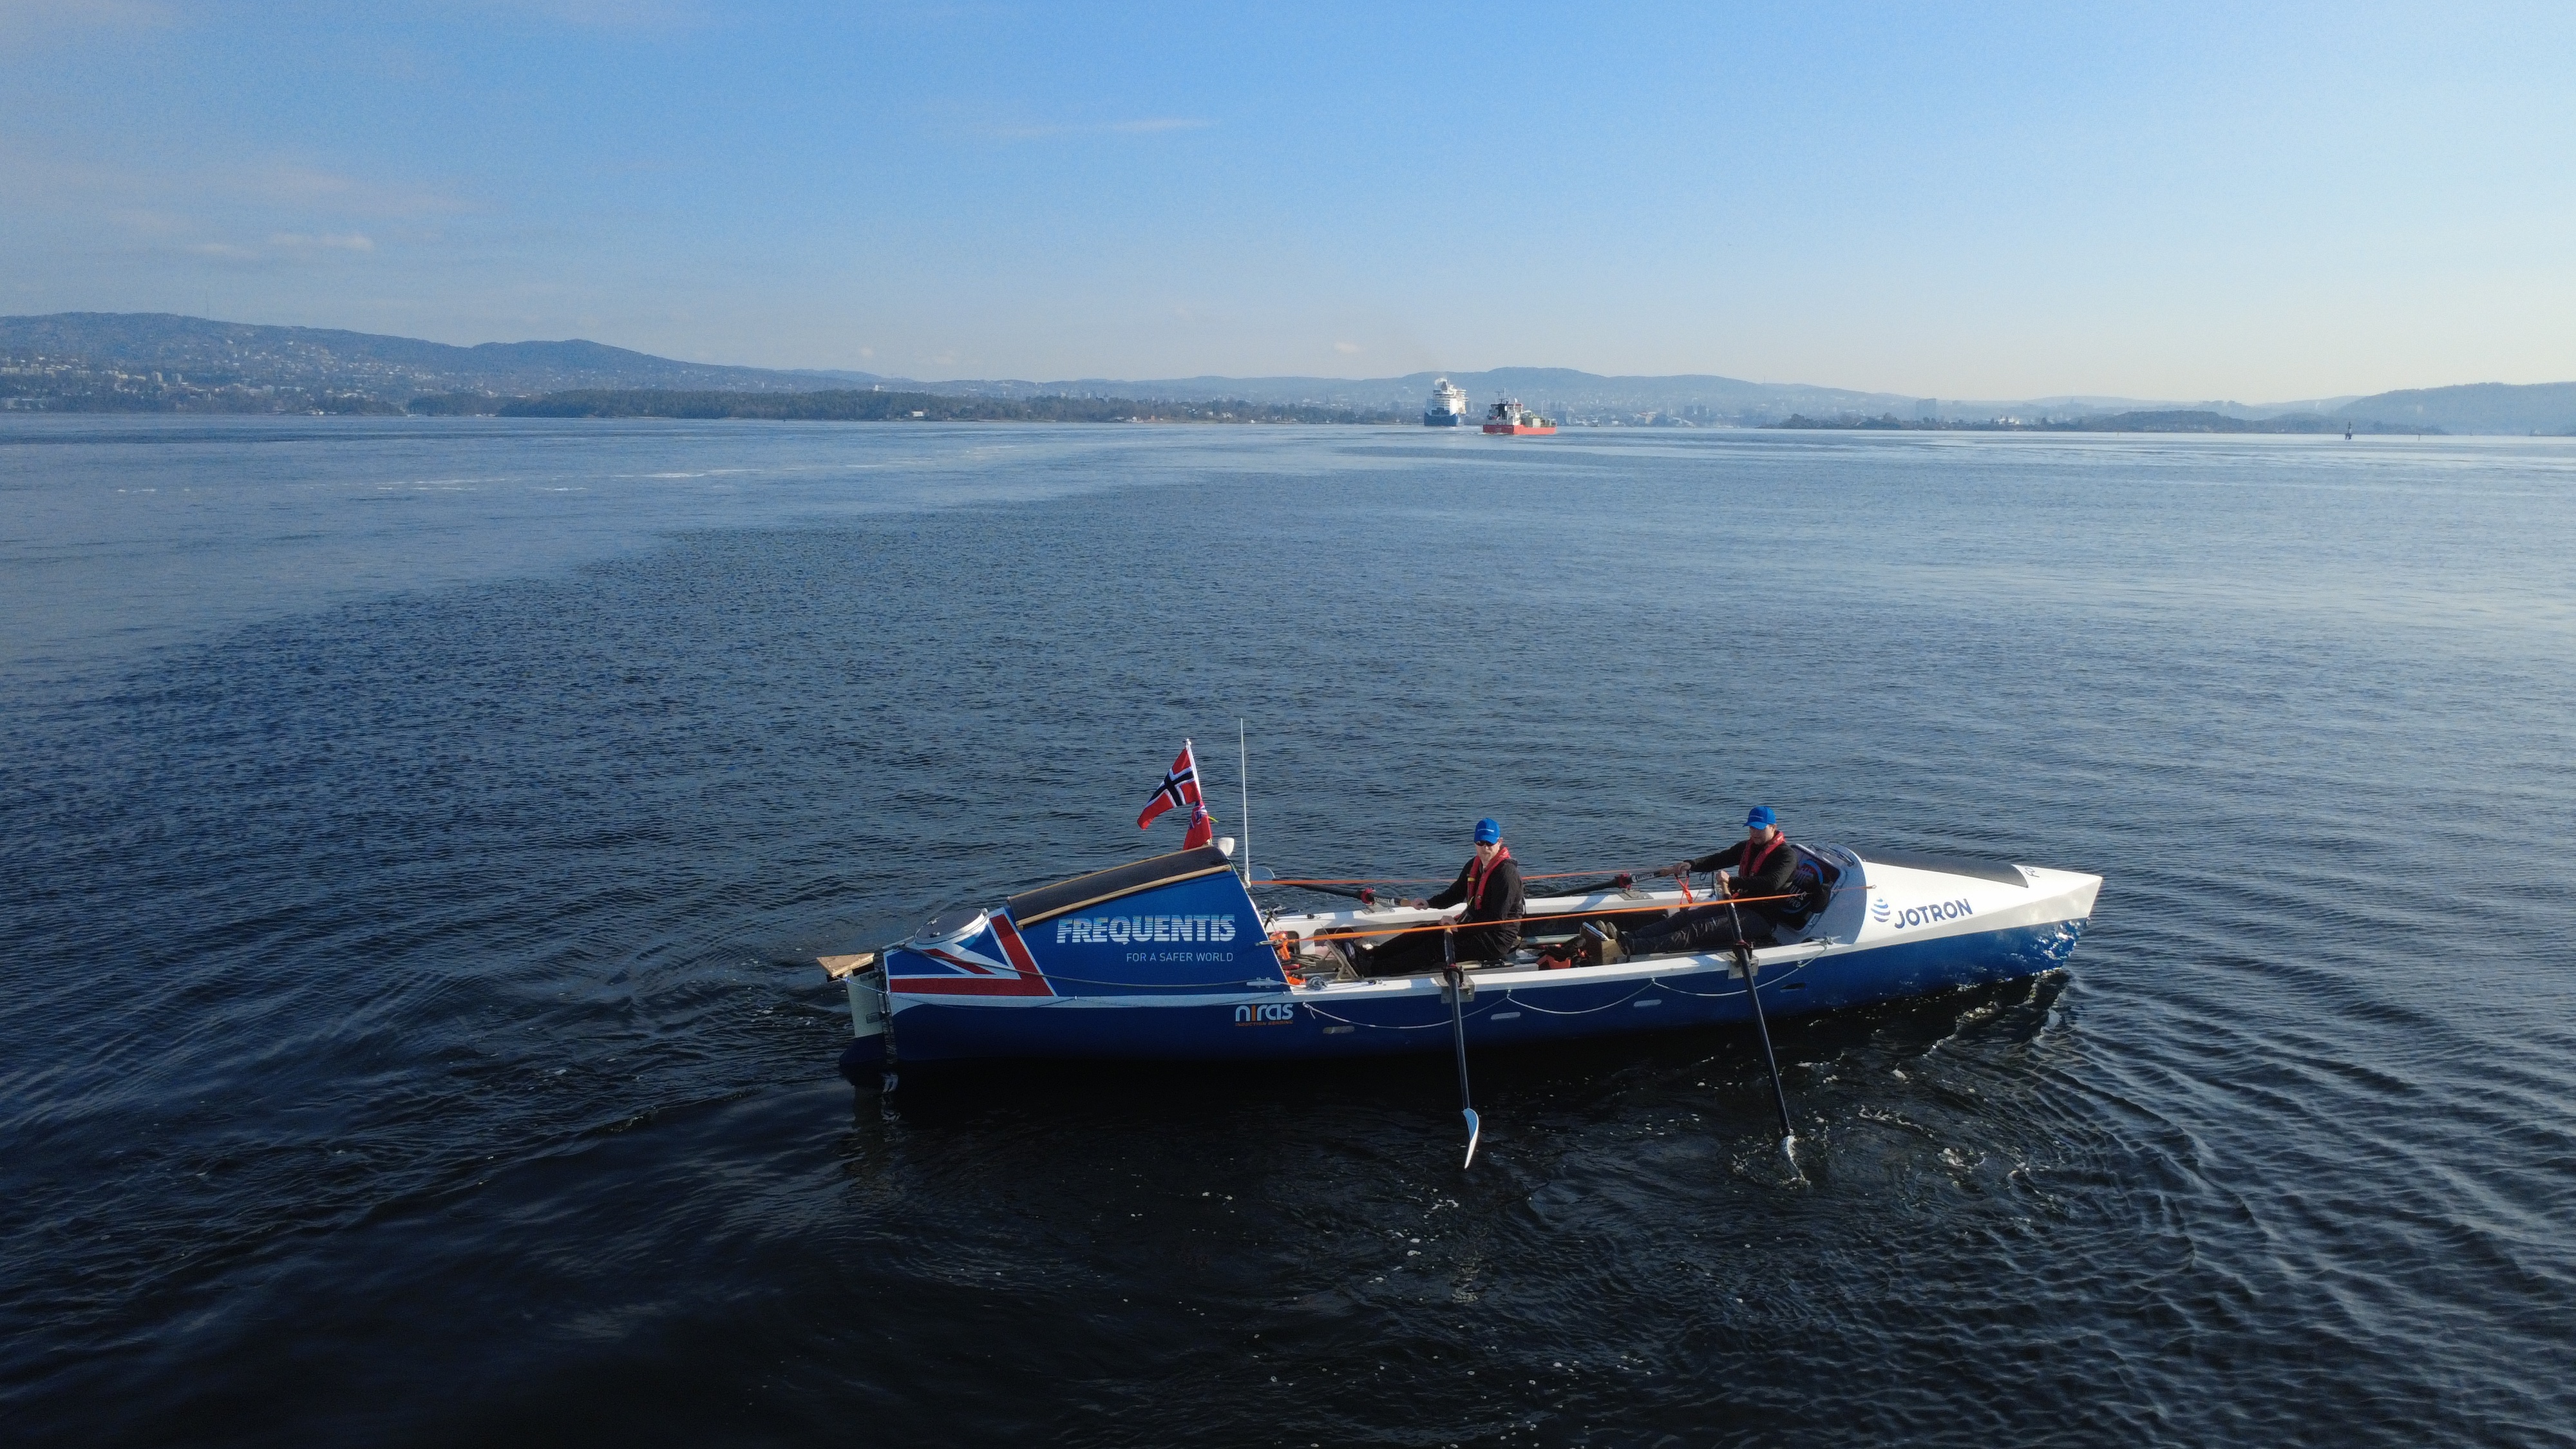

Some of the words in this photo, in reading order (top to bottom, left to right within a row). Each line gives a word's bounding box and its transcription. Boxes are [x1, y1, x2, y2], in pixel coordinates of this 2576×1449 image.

[1895, 898, 1973, 929] JOTRON
[1056, 914, 1236, 945] FREQUENTIS
[1126, 952, 1146, 962] FOR
[1149, 952, 1157, 961] A
[1159, 952, 1193, 961] SAFER
[1196, 952, 1233, 962] WORLD
